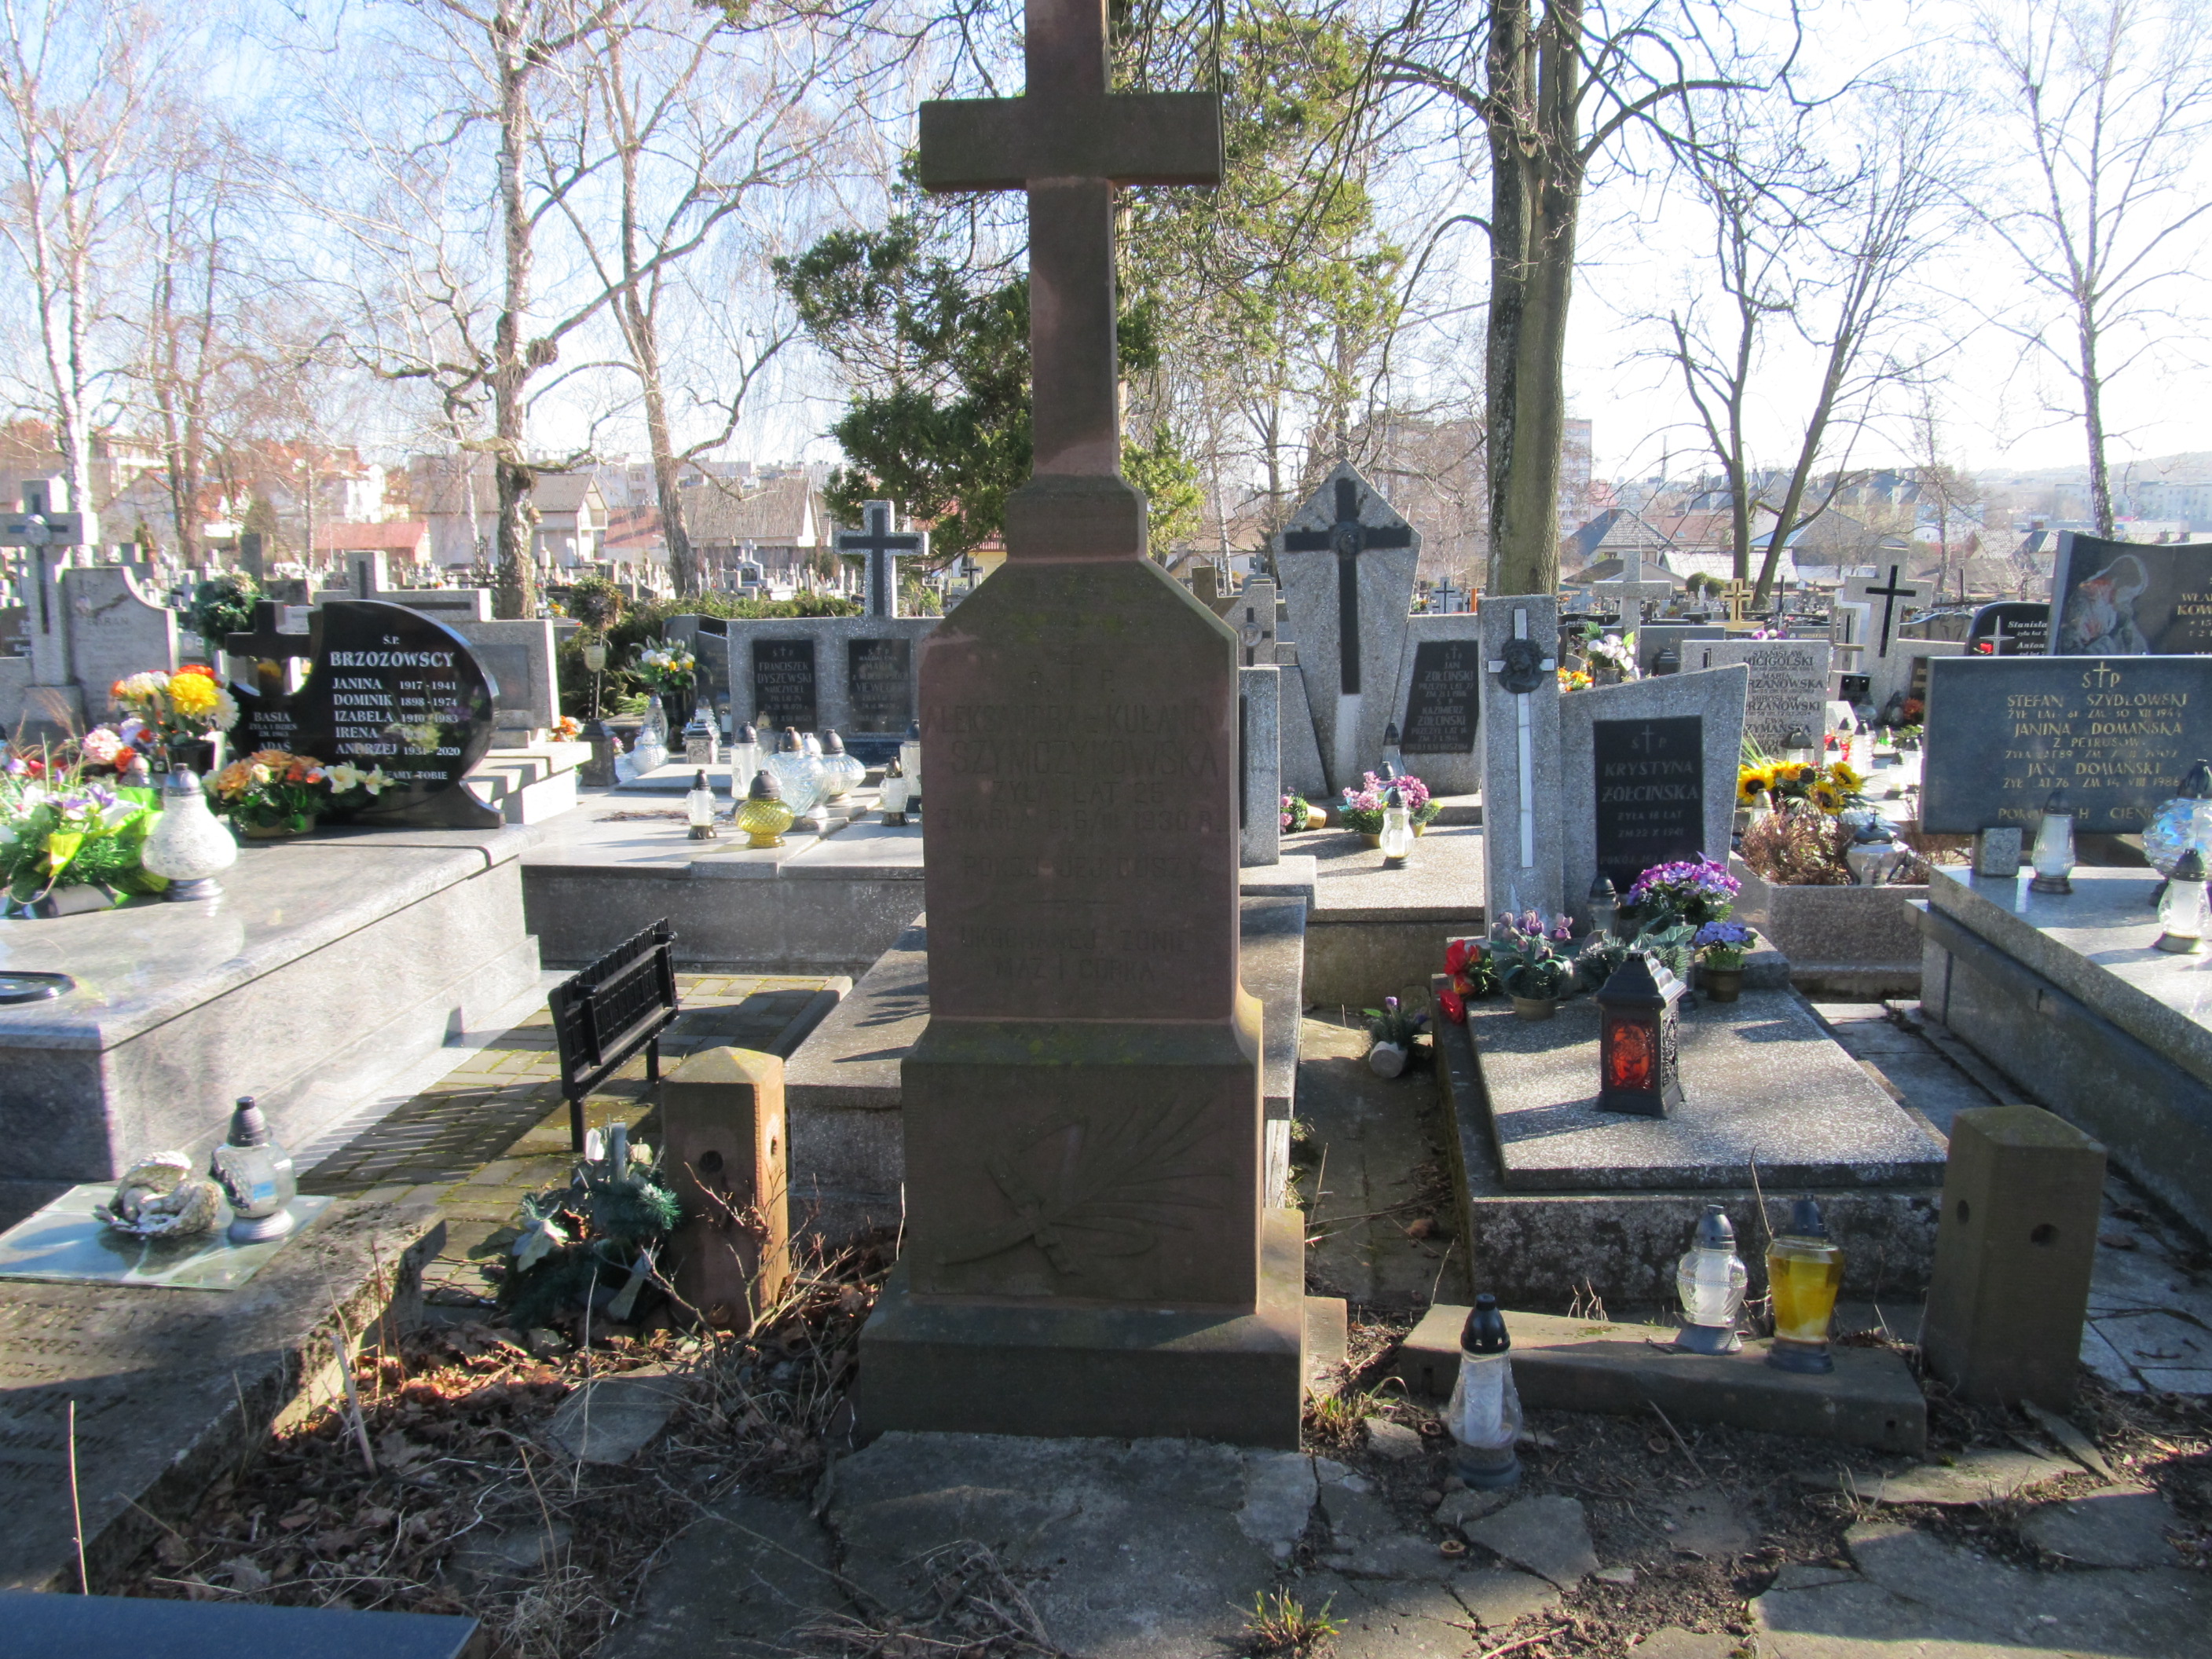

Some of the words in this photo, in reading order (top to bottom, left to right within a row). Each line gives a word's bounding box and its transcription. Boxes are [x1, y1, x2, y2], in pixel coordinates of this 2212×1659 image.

[330, 651, 455, 668] BRZOZOWSCY
[759, 661, 809, 671] FRANCISZEK
[332, 677, 383, 690] JANINA
[399, 681, 423, 690] 1917
[432, 681, 456, 690] 1941
[756, 673, 812, 683] DYSZEWSKI
[333, 694, 394, 706] DOMINIK
[401, 697, 425, 706] 1898
[433, 697, 457, 706] 1974
[2008, 694, 2064, 708] STEFAN
[1421, 705, 1464, 715] KAZIMIERZ
[253, 711, 291, 722] BASIA
[334, 710, 394, 722] IZABELA
[434, 714, 459, 723] 1983
[335, 727, 379, 738] IRENA
[2014, 723, 2071, 738] JANINA
[2092, 720, 2183, 736] DOMAŃSKA
[436, 746, 460, 756] 2020
[1604, 760, 1694, 777] KRYSTYNA
[2027, 763, 2056, 778] JAN
[416, 771, 448, 779] TOBIE
[1073, 781, 1116, 804] LAT
[1662, 810, 1683, 820] LAT
